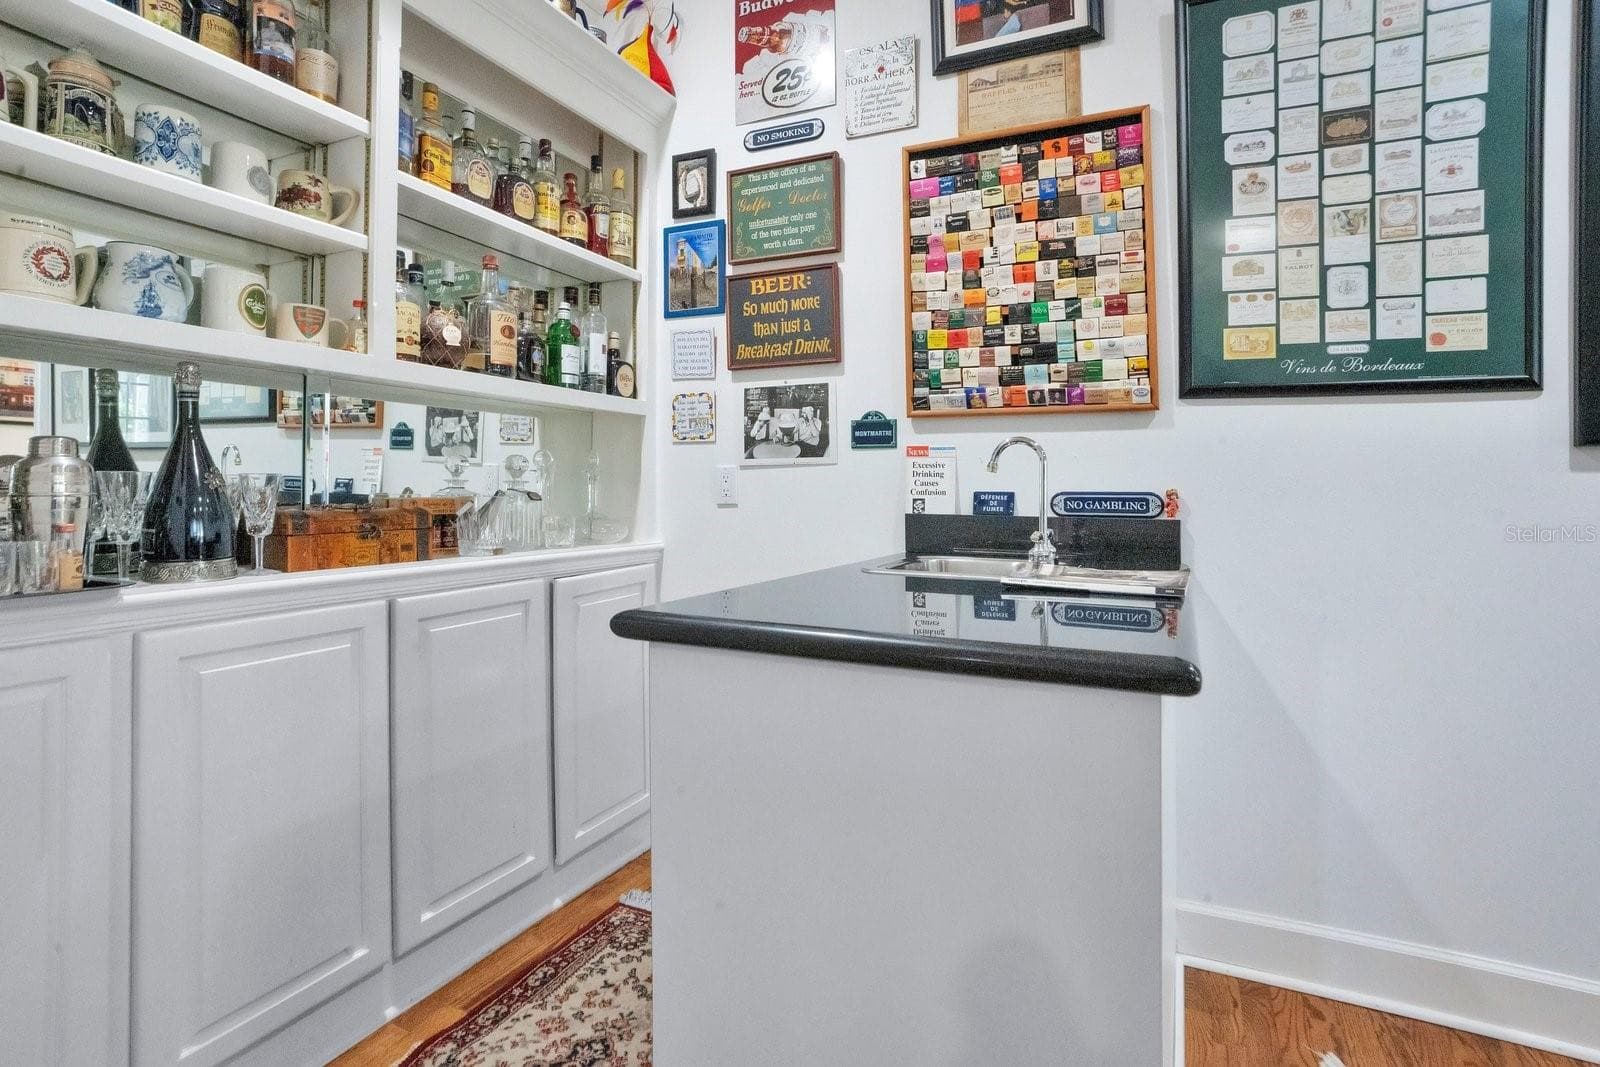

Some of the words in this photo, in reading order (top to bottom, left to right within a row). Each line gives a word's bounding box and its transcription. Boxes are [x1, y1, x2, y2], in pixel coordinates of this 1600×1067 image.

[757, 134, 770, 143] NO
[771, 126, 810, 140] SMOKING
[748, 174, 761, 183] This
[769, 170, 779, 179] the
[780, 168, 799, 177] office
[800, 165, 807, 173] of
[741, 182, 778, 196] experienced
[780, 181, 792, 190] and
[793, 174, 824, 187] dedicated
[749, 215, 789, 229] unfortunately
[790, 212, 803, 223] only
[805, 211, 817, 219] one
[751, 231, 758, 240] of
[759, 230, 769, 239] the
[771, 229, 782, 237] two
[783, 225, 798, 235] titles
[800, 223, 815, 234] pays
[763, 240, 781, 249] worth
[750, 272, 812, 296] BEER:
[743, 300, 758, 316] So
[781, 318, 801, 336] just
[803, 318, 812, 332] a
[1280, 358, 1317, 374] Vins
[1320, 360, 1337, 373] de
[1341, 357, 1424, 372] Bordeaux
[908, 448, 929, 456] NEWS
[912, 461, 946, 469] Excessive
[912, 470, 945, 479] Drinking
[914, 479, 939, 487] Causes
[910, 488, 947, 496] Confusion
[1066, 500, 1083, 509] NO
[1084, 500, 1147, 510] GAMBLING
